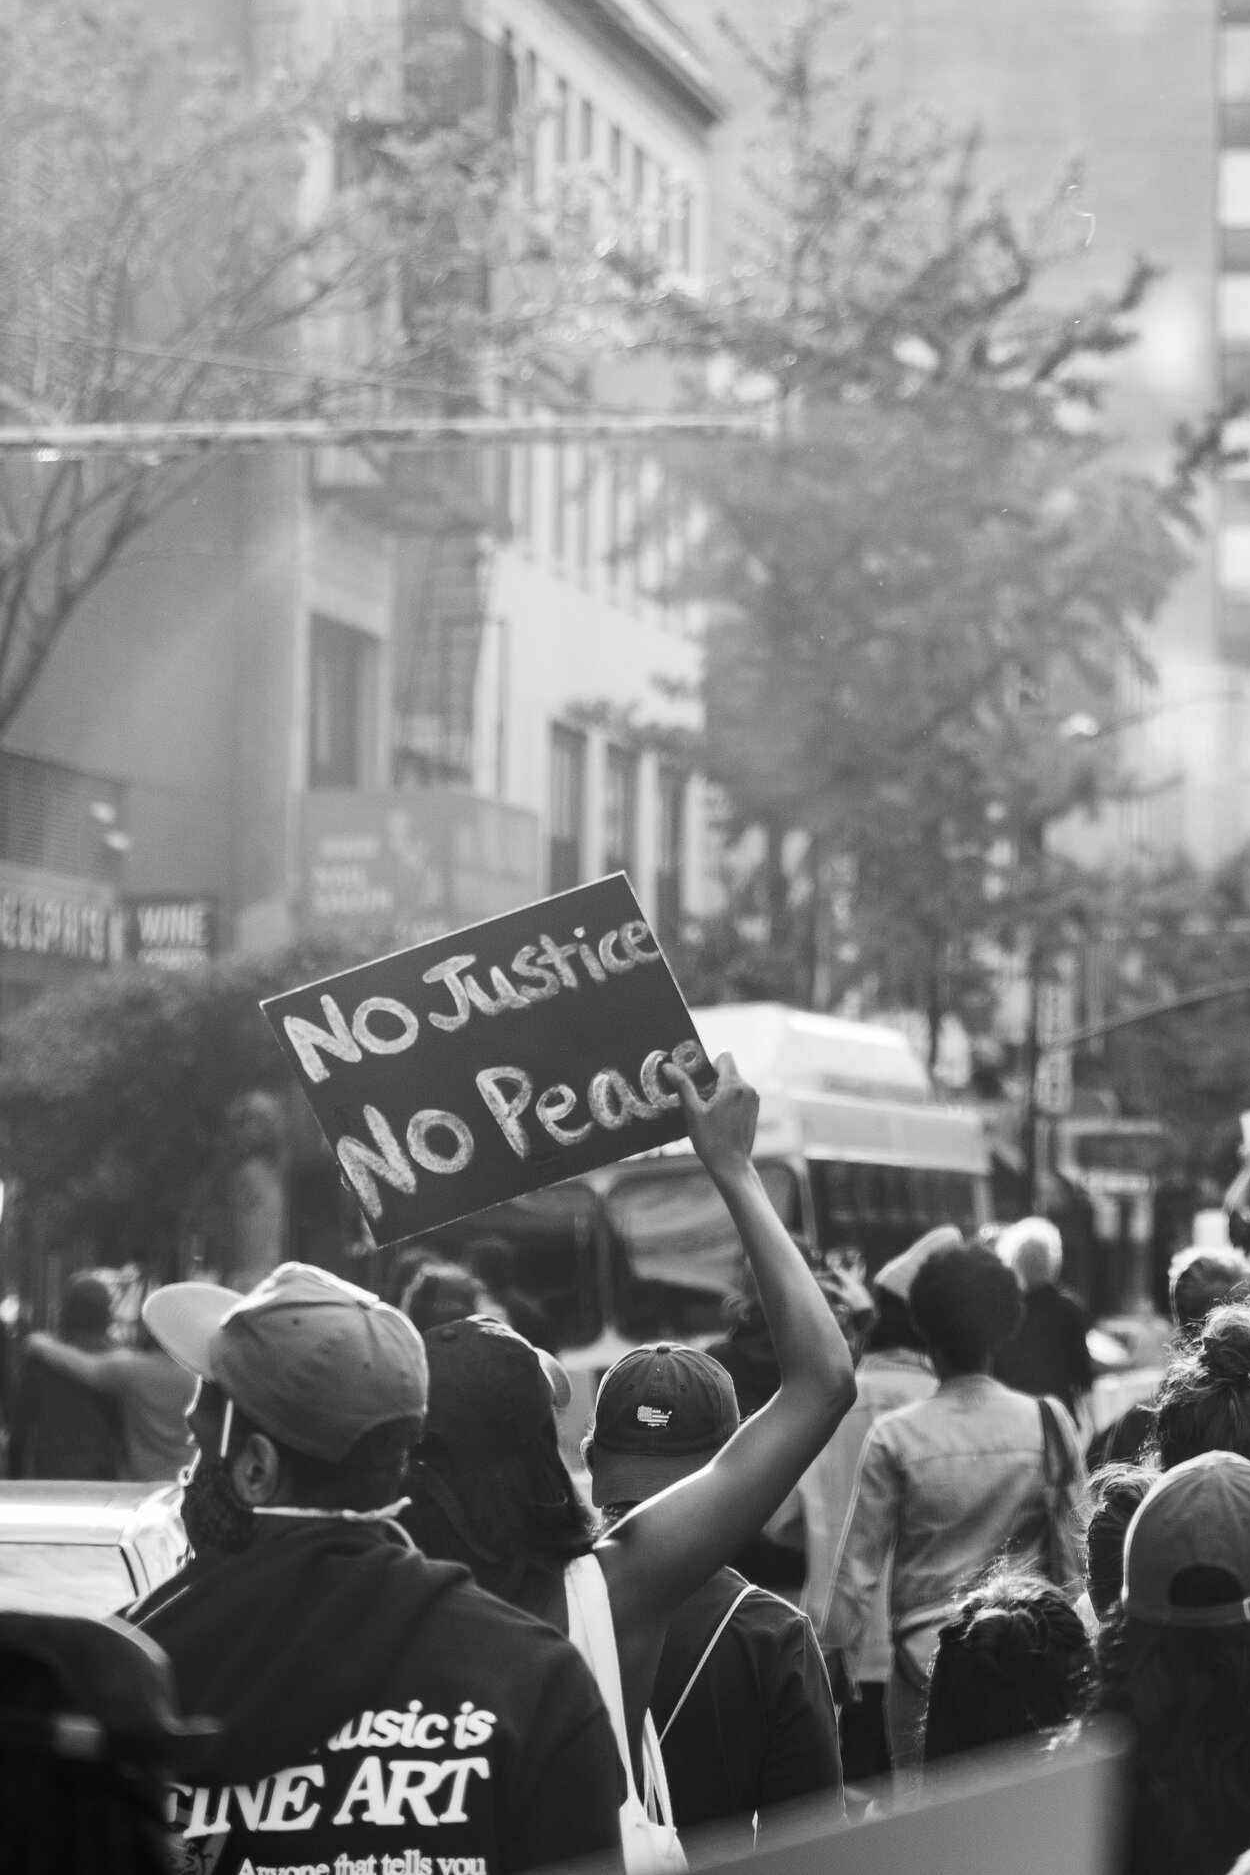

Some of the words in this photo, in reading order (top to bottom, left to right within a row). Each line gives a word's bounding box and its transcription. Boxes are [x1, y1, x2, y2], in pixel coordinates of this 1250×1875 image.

[422, 920, 662, 1032] Justice
[326, 1699, 450, 1752] usic
[453, 1700, 498, 1751] is
[332, 1755, 491, 1827] ART
[333, 1853, 378, 1875] that
[381, 1848, 432, 1875] tells
[436, 1857, 488, 1875] you
